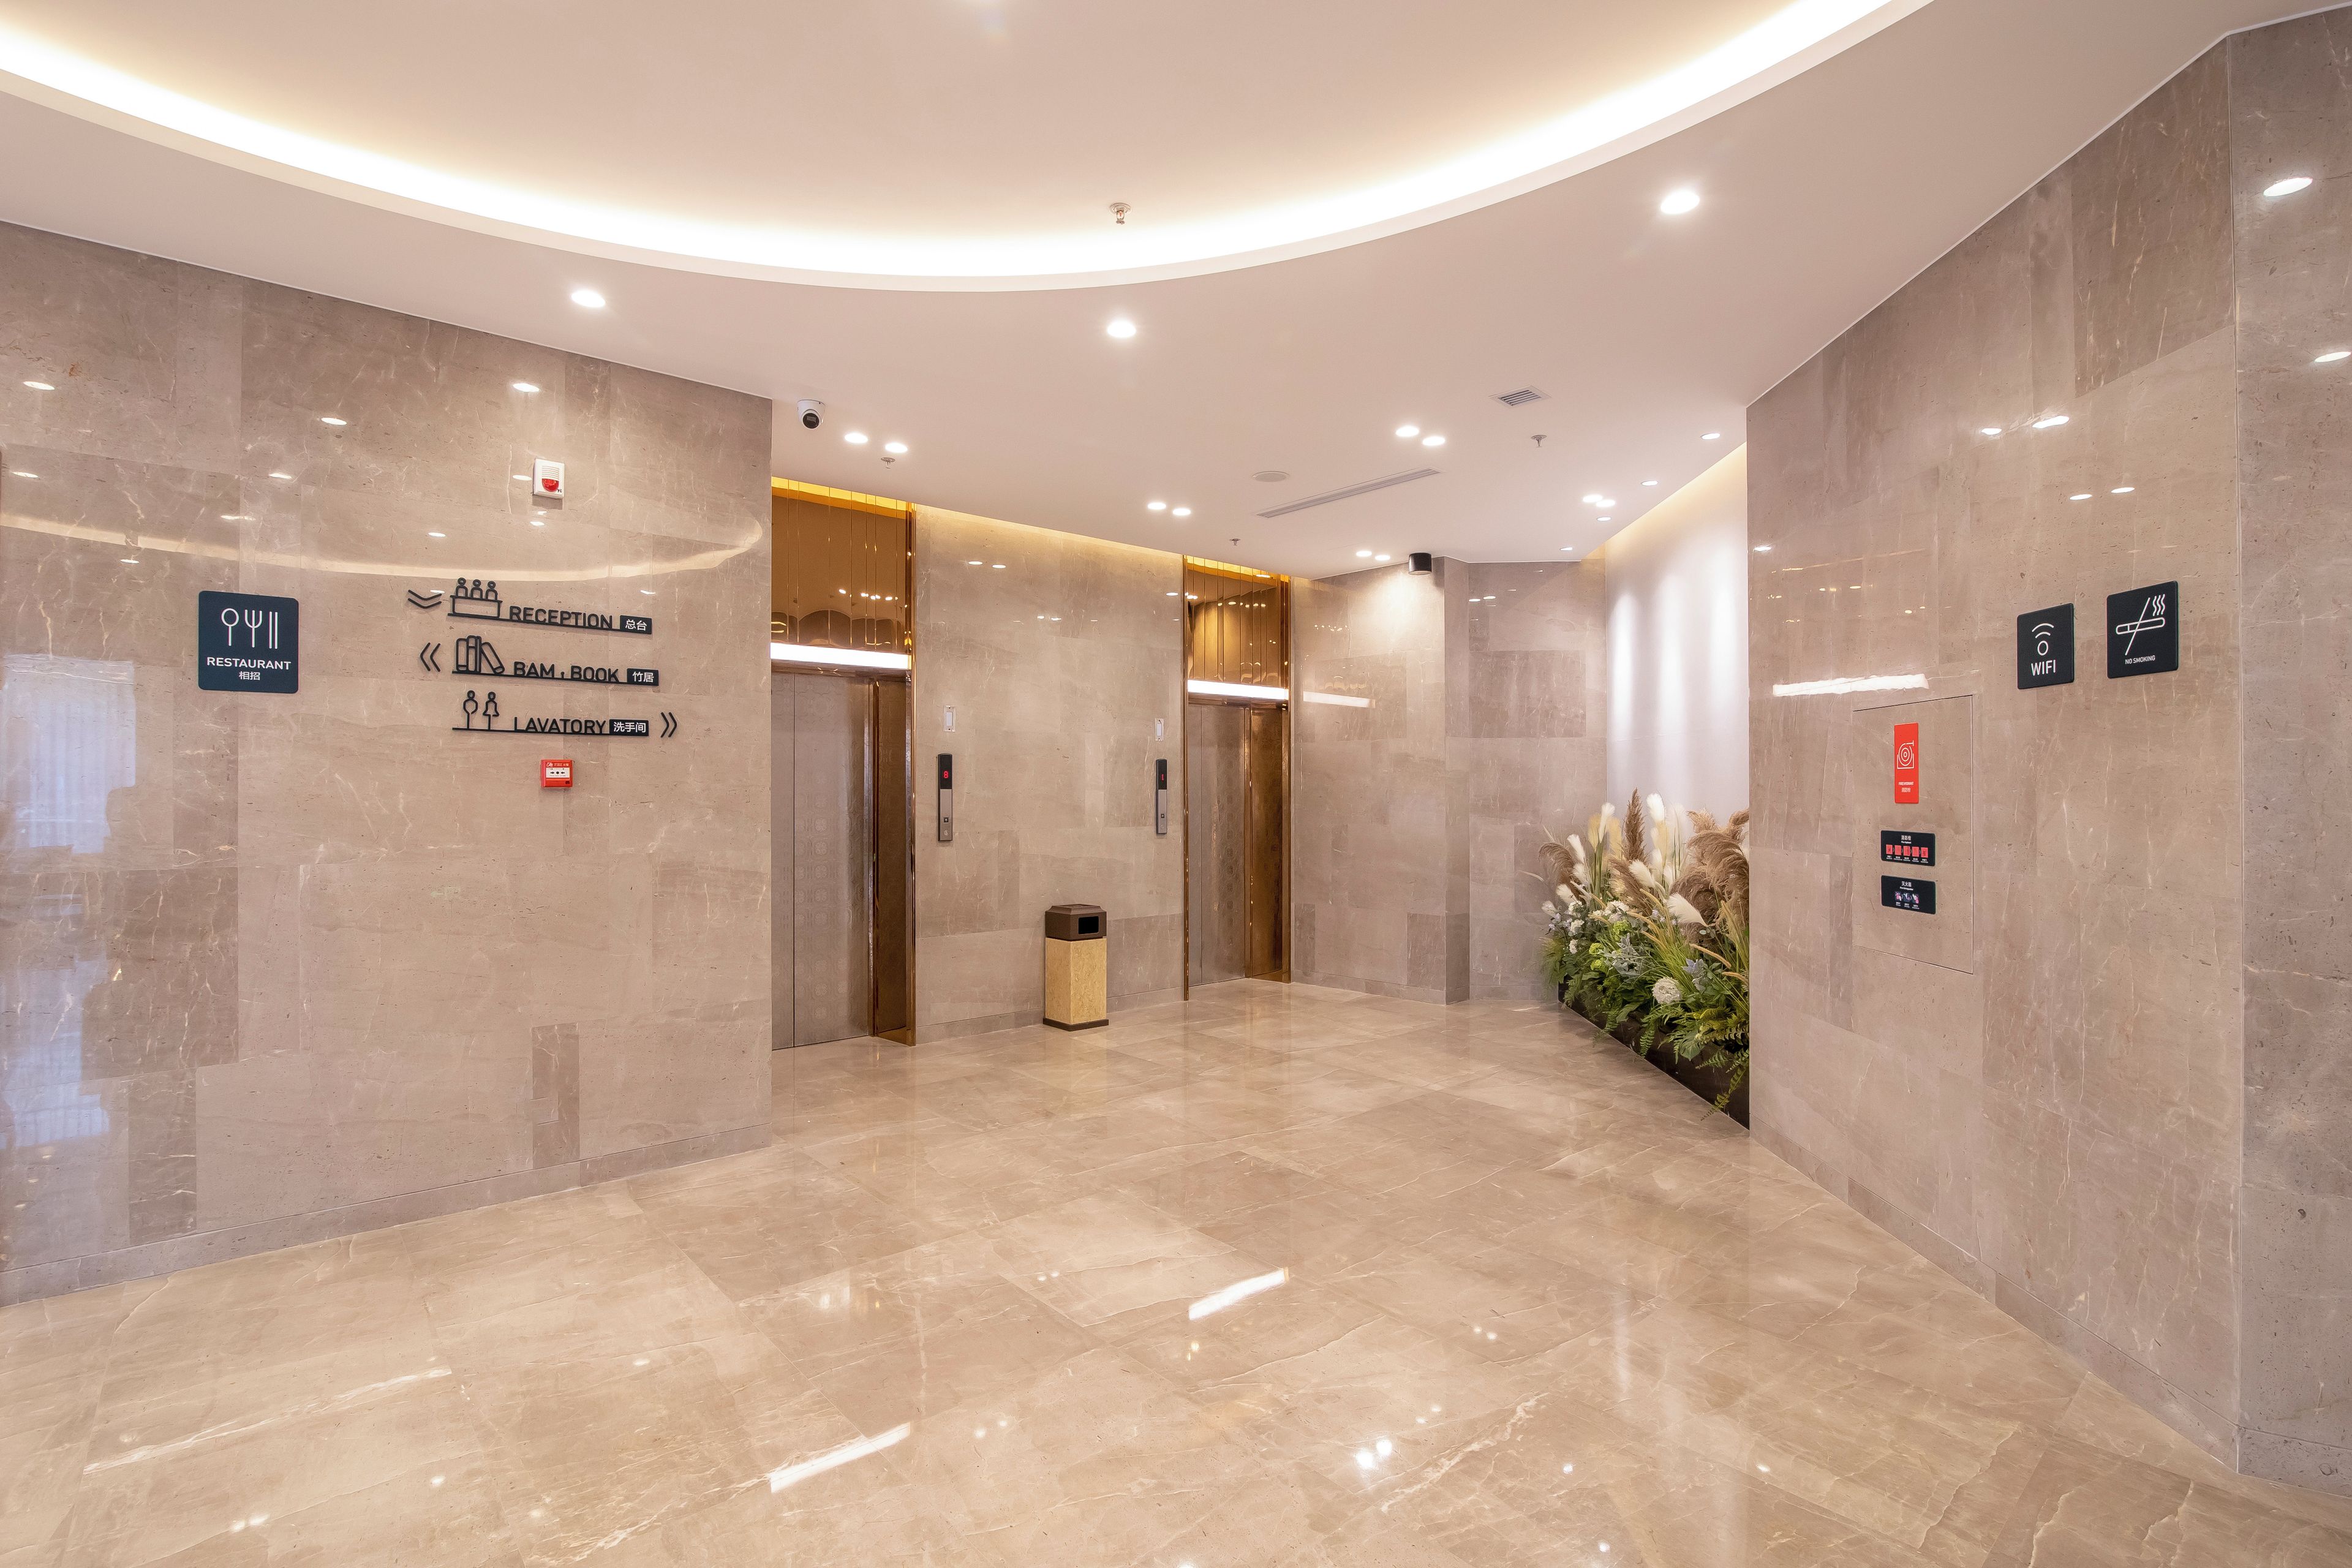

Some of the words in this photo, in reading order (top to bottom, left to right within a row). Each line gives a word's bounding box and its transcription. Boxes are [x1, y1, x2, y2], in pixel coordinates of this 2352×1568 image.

[509, 605, 612, 628] RECEPTION
[625, 619, 647, 631] 总台
[206, 657, 291, 670] RESTAURANT
[2133, 655, 2155, 663] SMOKING
[514, 661, 555, 678] BAM
[571, 665, 620, 682] BOOK
[2031, 660, 2056, 676] WIFI
[238, 671, 260, 680] 相招
[632, 671, 654, 683] 竹居
[514, 717, 606, 734] LAVATORY
[613, 722, 646, 733] 洗手间
[943, 770, 949, 778] 8
